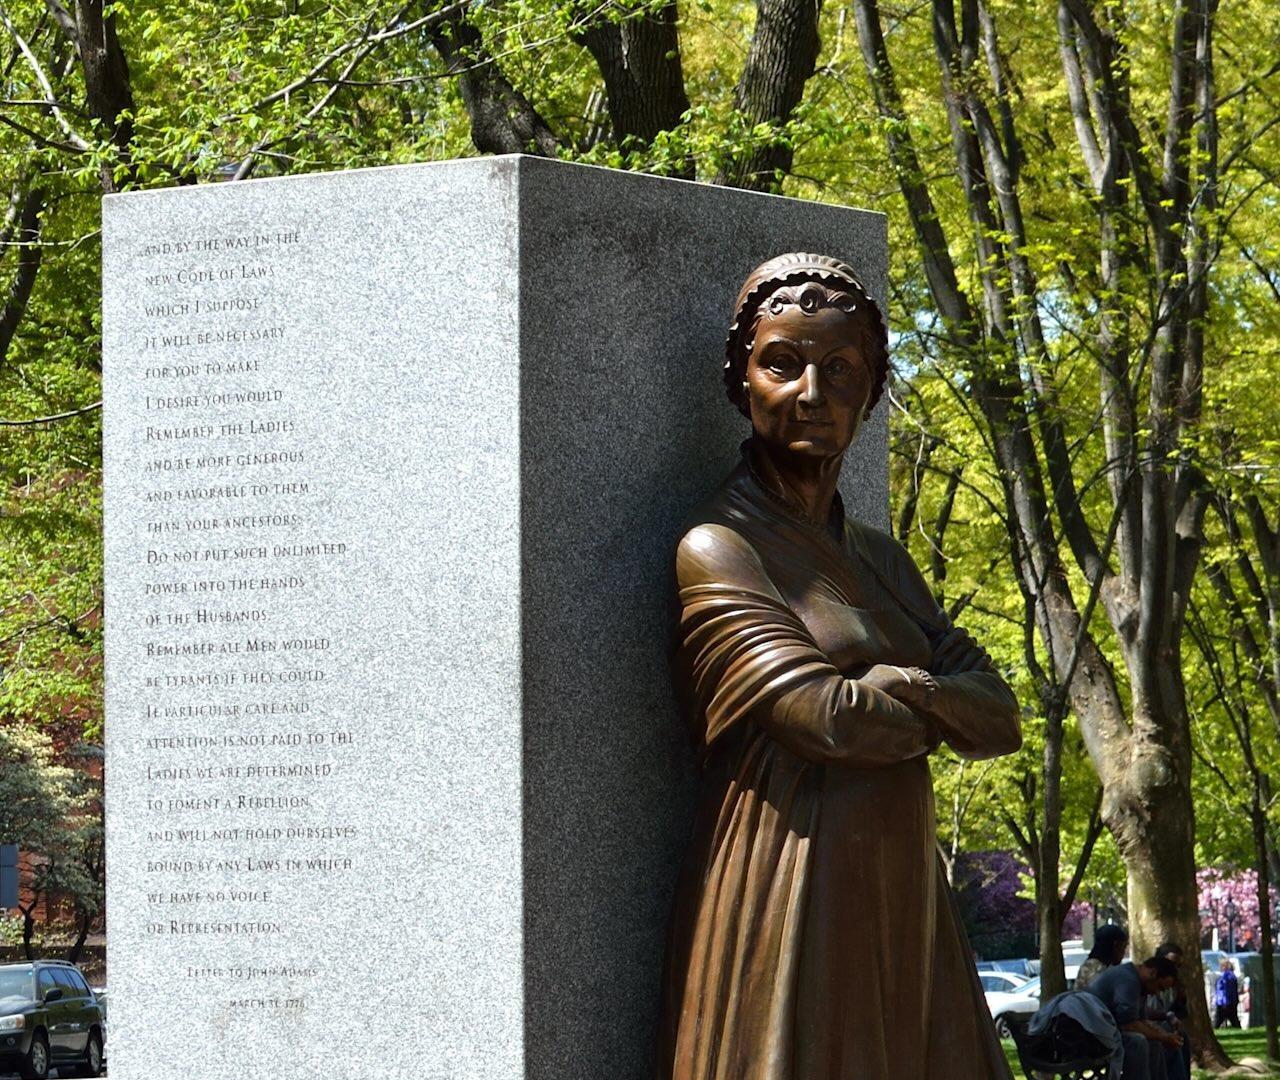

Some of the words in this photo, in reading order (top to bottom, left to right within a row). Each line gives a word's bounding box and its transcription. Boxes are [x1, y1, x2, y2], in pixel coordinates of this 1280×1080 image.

[196, 240, 219, 251] THE
[225, 236, 251, 248] WAY
[256, 235, 270, 246] IN
[276, 232, 300, 244] THE
[145, 275, 172, 287] NEW
[177, 269, 214, 284] CODE
[219, 269, 234, 280] OF
[241, 265, 275, 279] LAWS
[145, 303, 188, 317] WHICH
[206, 299, 260, 312] SUPPOSE
[162, 334, 190, 346] WILL
[197, 333, 214, 345] BE
[217, 327, 286, 342] NECESSARY
[145, 367, 168, 379] FOR
[173, 365, 199, 377] YOU
[205, 363, 221, 375] TO
[227, 361, 259, 373] MAKE
[157, 396, 199, 409] DESIRE
[204, 394, 230, 407] YOU
[235, 390, 282, 404] WOULD
[146, 425, 213, 441] REMEMBER
[221, 423, 244, 436] THE
[250, 420, 295, 434] LADIES
[146, 460, 171, 472] AND
[177, 459, 191, 470] BE
[196, 456, 232, 468] MORE
[237, 451, 304, 466] GENEROUS
[146, 490, 172, 502] AND
[177, 486, 246, 500] FAVORABLE
[251, 485, 268, 496] TO
[274, 483, 309, 494] THEM
[148, 521, 180, 533] THAN
[185, 519, 219, 531] YOUR
[147, 551, 167, 565] DO
[173, 550, 199, 562] NOT
[205, 549, 229, 561] PUT
[234, 547, 267, 560] SUCH
[145, 582, 187, 595] POWER
[193, 581, 225, 592] INTO
[229, 578, 256, 590] THE
[260, 577, 305, 589] HANDS
[145, 614, 161, 626] OF
[167, 613, 190, 625] THE
[147, 642, 214, 656] REMEMBER
[220, 642, 241, 653] ALL
[246, 639, 277, 652] MEN
[282, 638, 330, 650] WOULD
[165, 674, 219, 686] TYRANTS
[242, 672, 273, 683] THEY
[245, 704, 277, 715] CARE
[282, 702, 310, 714] AND
[146, 736, 218, 749] ATTENTION
[240, 735, 266, 746] NOT
[272, 734, 301, 745] PAID
[308, 733, 324, 744] TO
[330, 732, 353, 744] THE
[196, 767, 213, 779] WE
[220, 766, 240, 778] ARE
[146, 830, 173, 841] AND
[178, 829, 206, 841] WILL
[213, 829, 239, 840] NOT
[245, 828, 282, 839] HOLD
[147, 861, 192, 873] BOUND
[198, 861, 212, 872] BY
[217, 860, 241, 872] ANY
[248, 857, 281, 871] LAWS
[286, 858, 300, 870] IN
[306, 858, 353, 870] WHICH
[170, 892, 201, 903] HAVE
[207, 891, 225, 902] NO
[147, 923, 163, 934] OR
